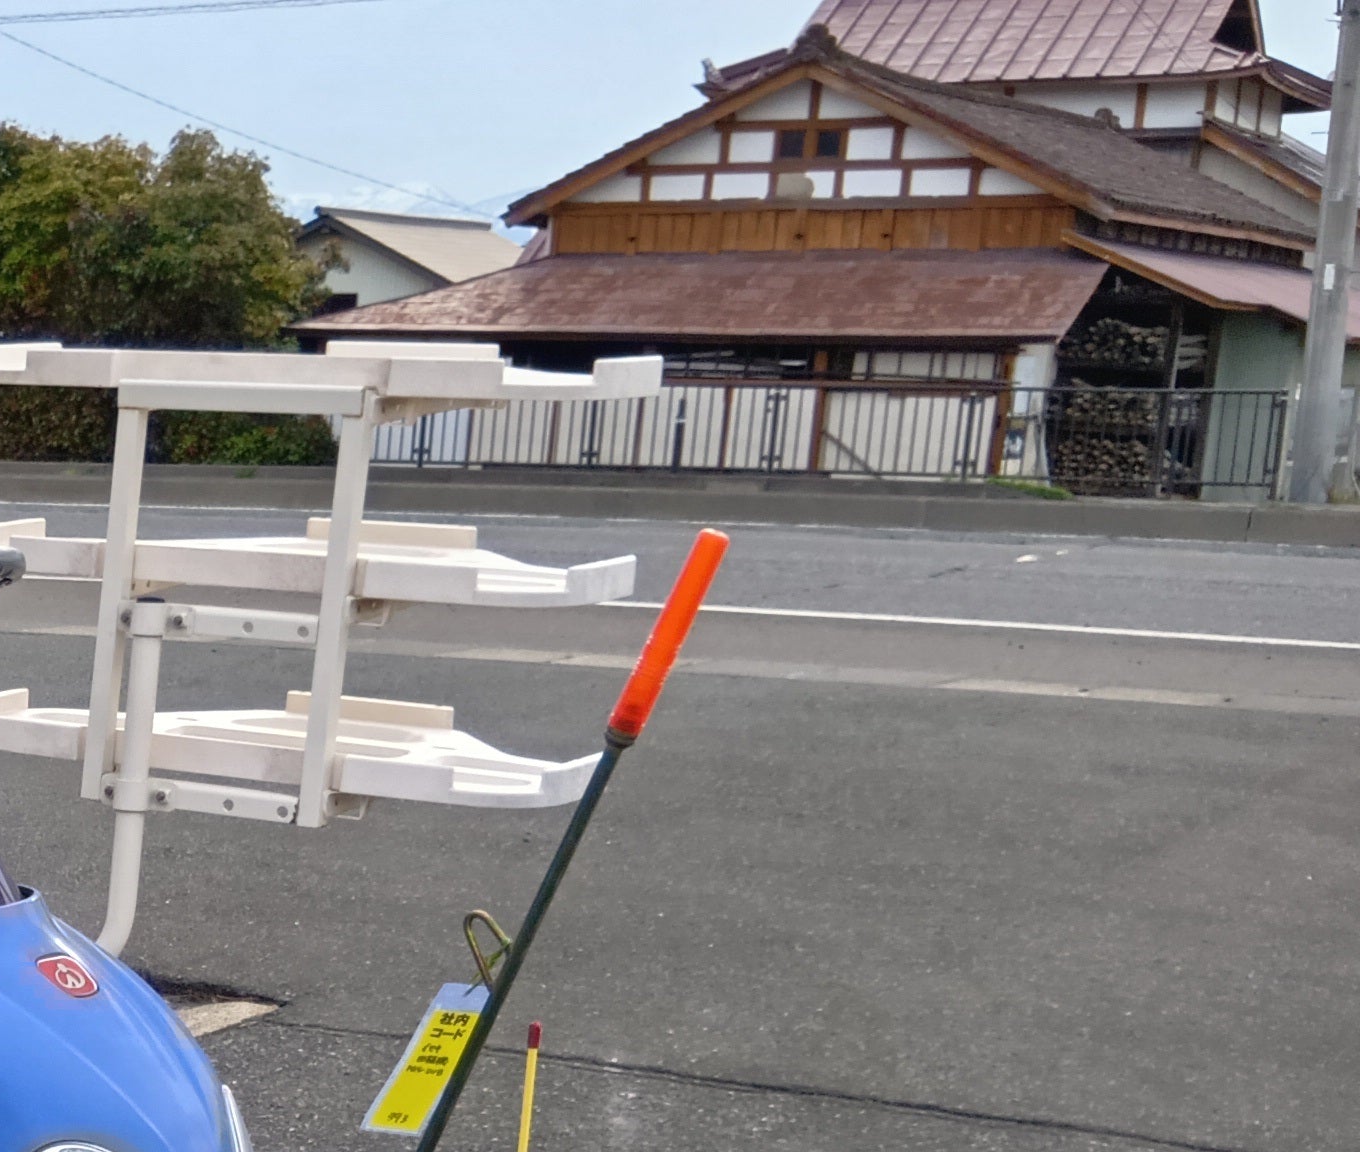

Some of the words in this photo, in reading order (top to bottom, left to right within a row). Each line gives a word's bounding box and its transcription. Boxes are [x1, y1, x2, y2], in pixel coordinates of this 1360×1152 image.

[440, 1013, 470, 1027] 社内
[430, 1028, 467, 1040] コード
